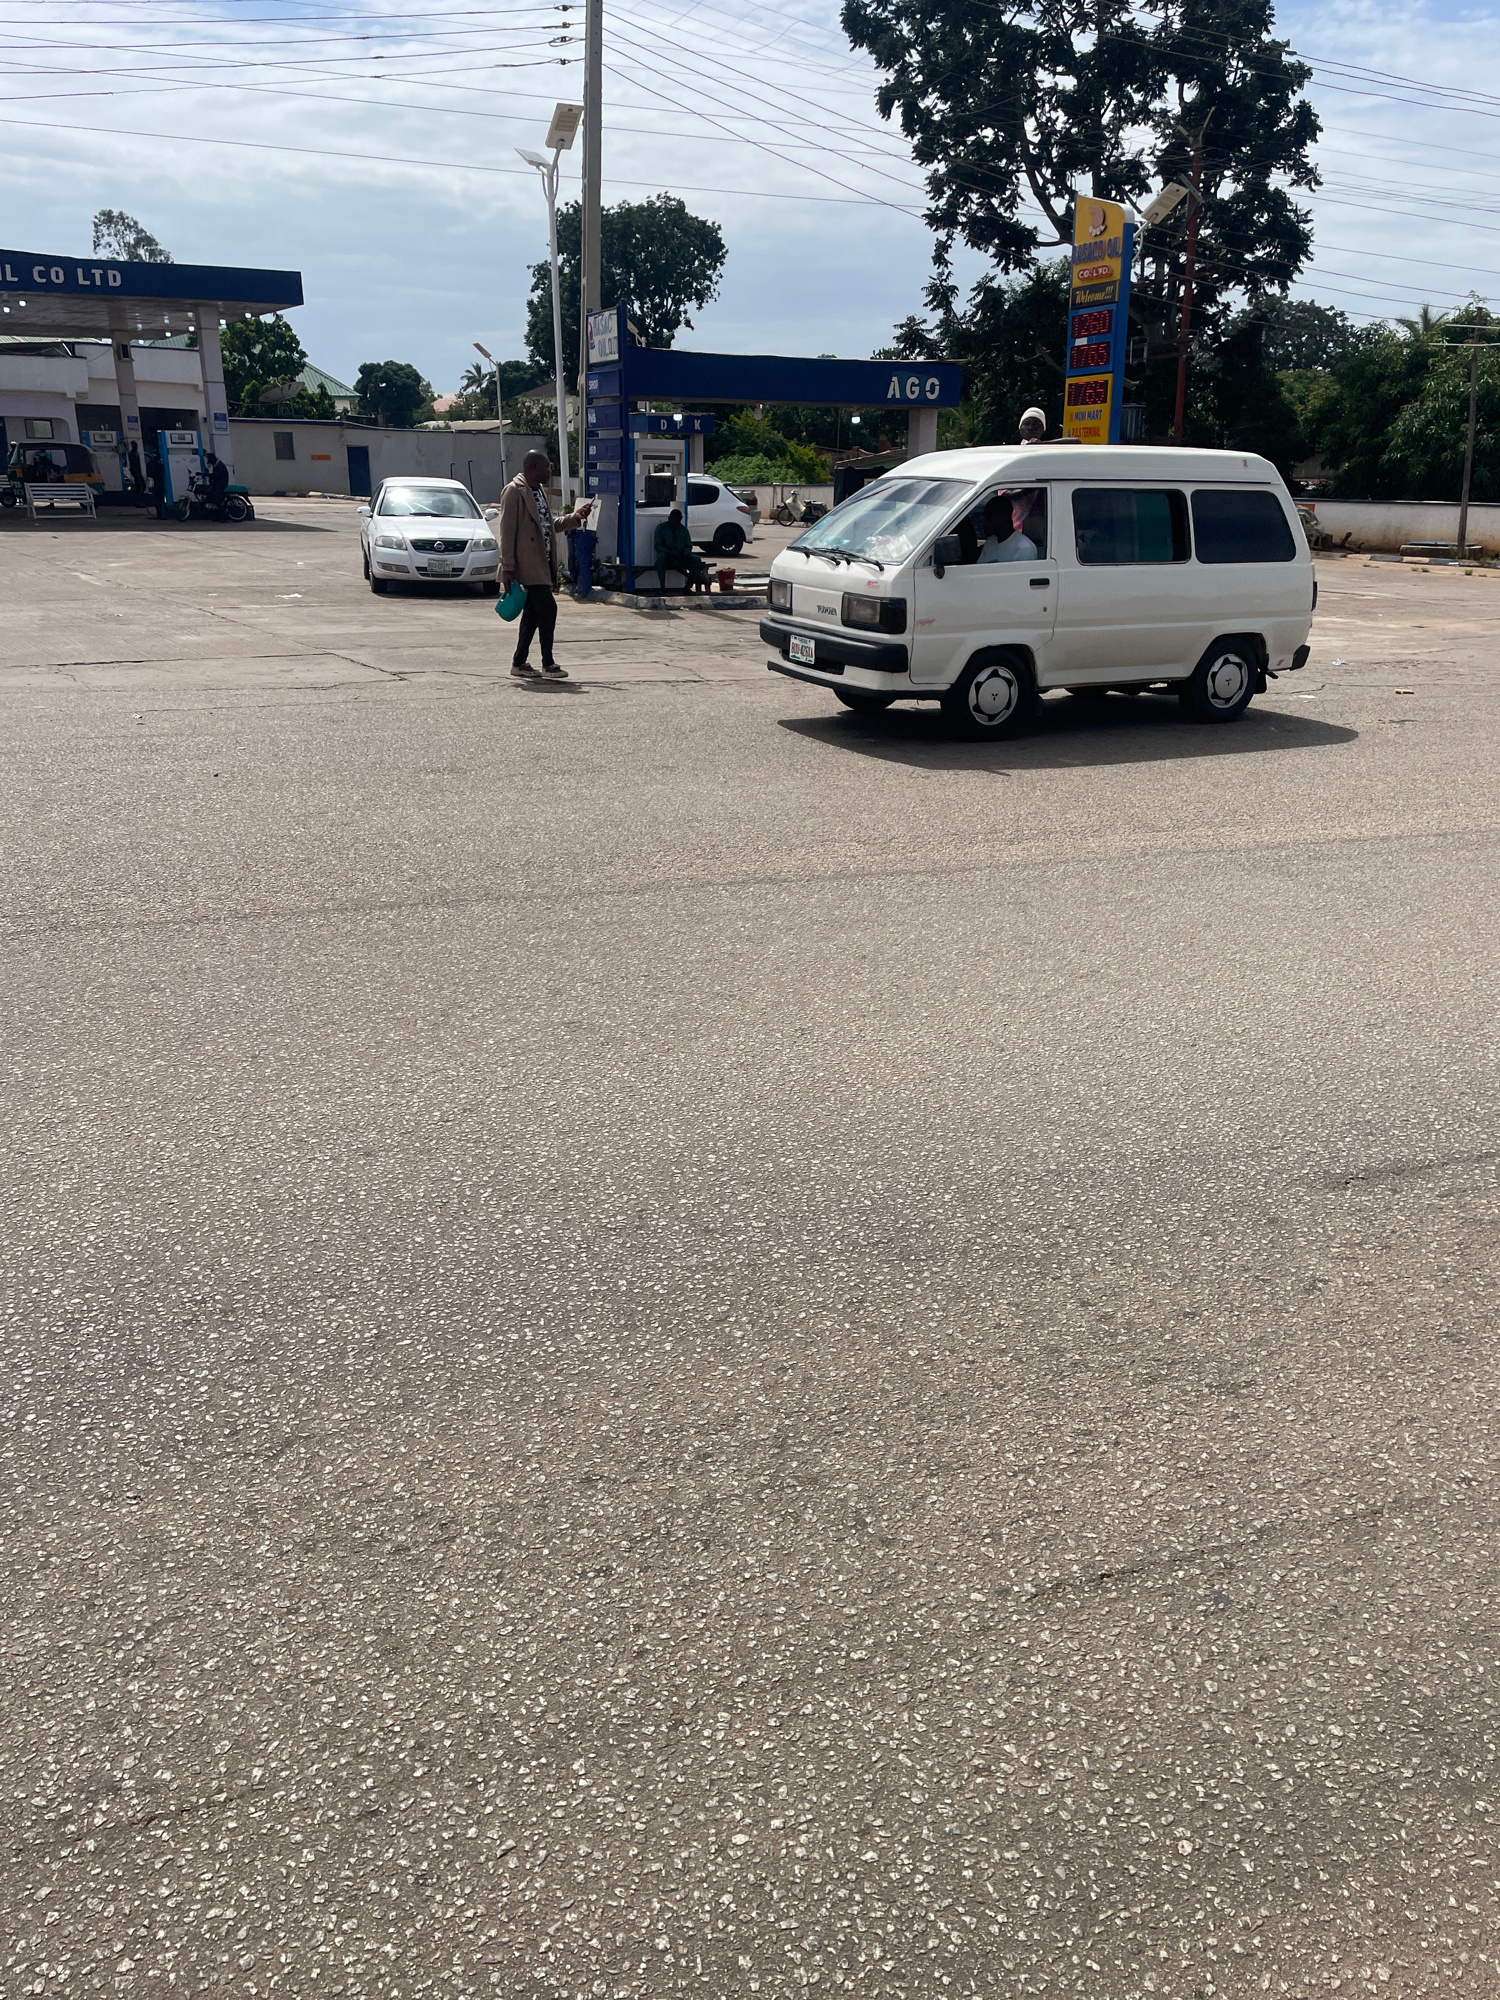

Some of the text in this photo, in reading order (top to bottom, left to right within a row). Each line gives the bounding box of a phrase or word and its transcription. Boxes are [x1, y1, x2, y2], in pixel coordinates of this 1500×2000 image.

[32, 265, 65, 284] CO
[77, 267, 122, 287] LTD
[886, 376, 940, 400] AGO
